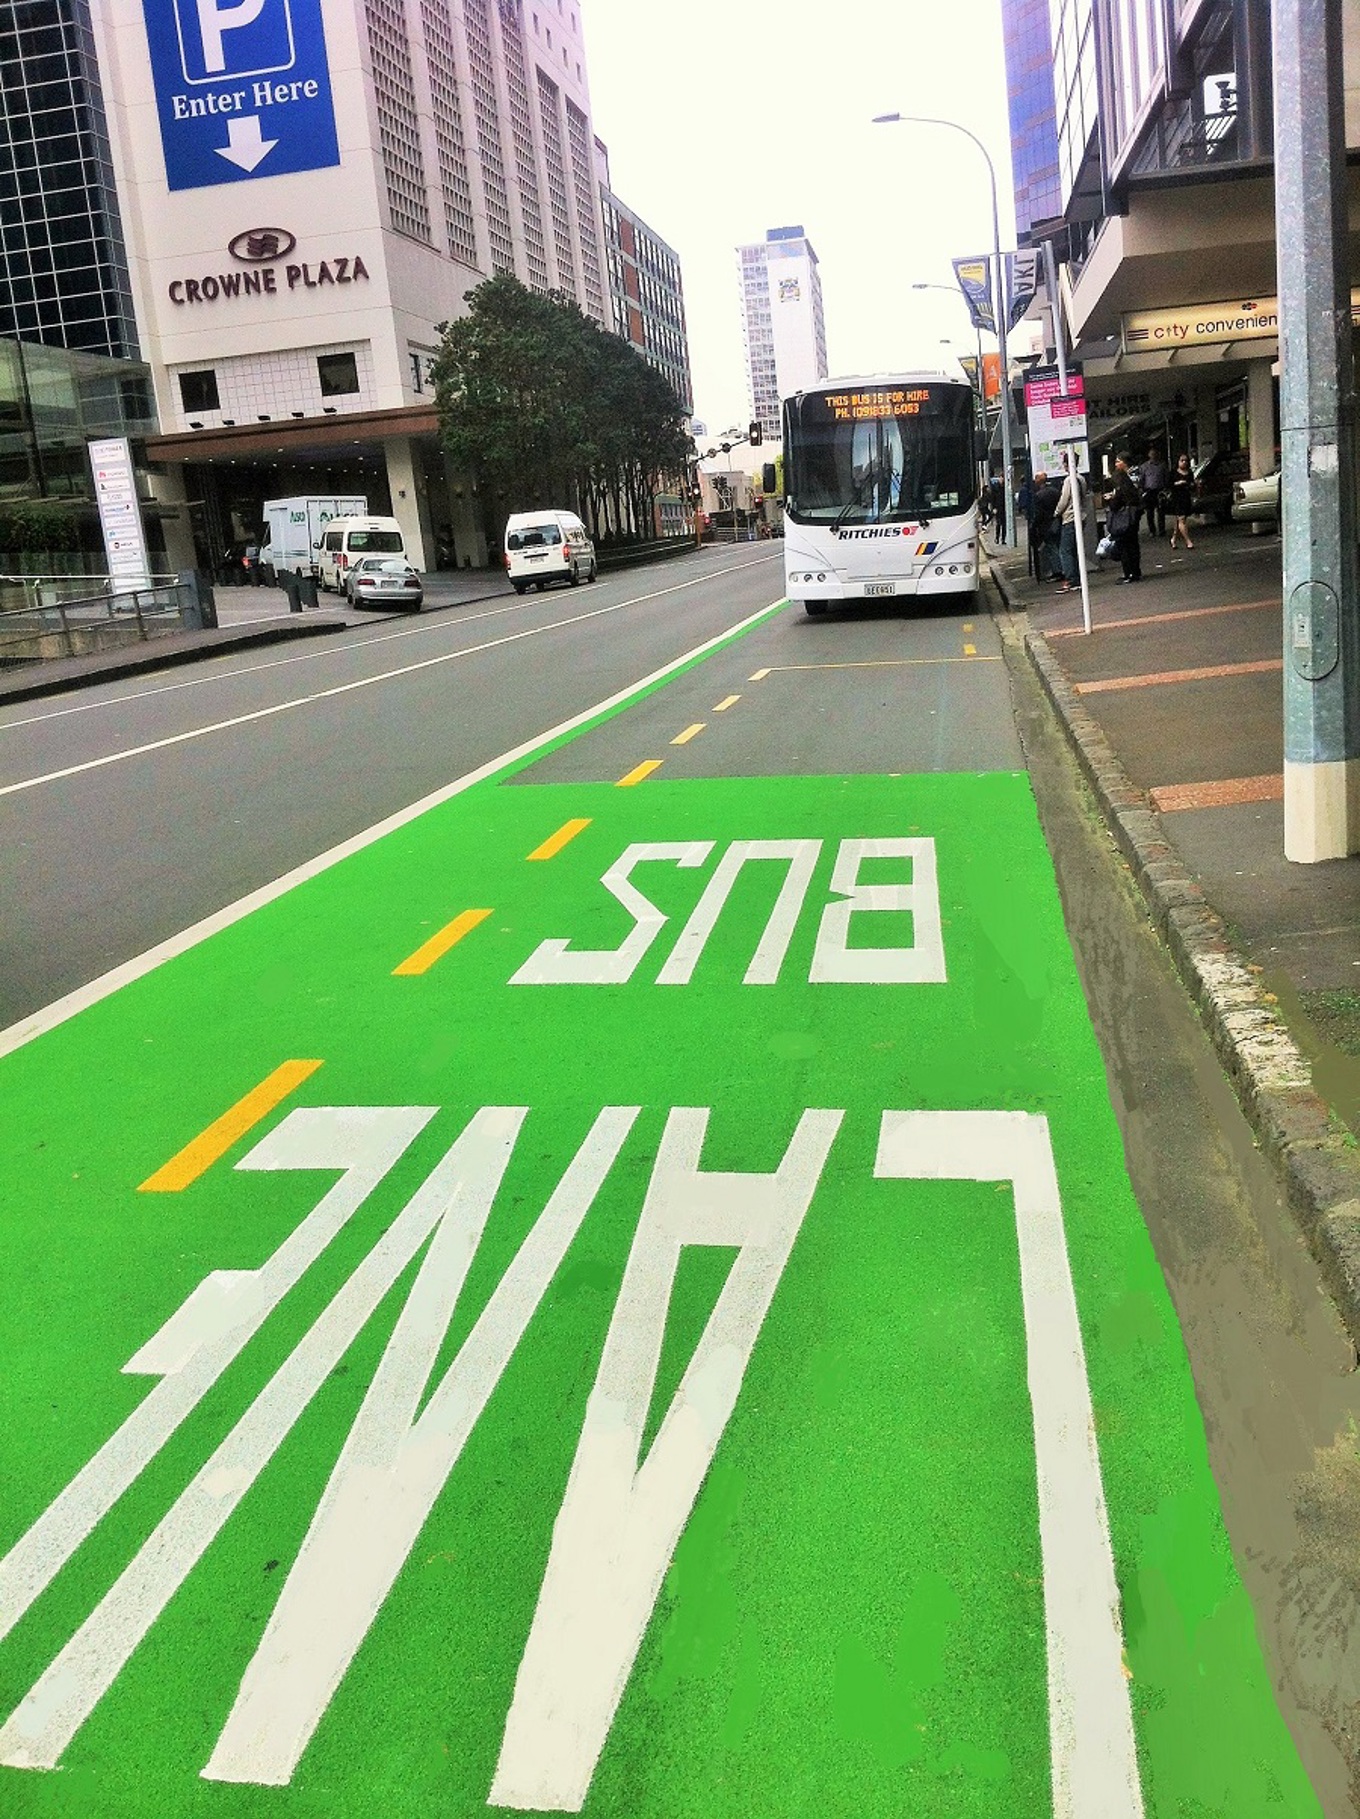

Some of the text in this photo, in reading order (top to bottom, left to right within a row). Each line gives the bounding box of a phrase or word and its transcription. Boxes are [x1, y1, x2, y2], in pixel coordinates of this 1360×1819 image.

[196, 0, 262, 73] P
[172, 79, 319, 120] Enter Here
[168, 256, 370, 304] CROWNE PLAZA
[1195, 313, 1278, 336] convenien
[825, 390, 929, 407] THIS BUS IS FOR HIRE
[1089, 403, 1152, 419] AILORS
[839, 527, 901, 540] RITCHIES
[508, 837, 947, 986] BUS
[0, 1105, 1146, 1819] LANE
